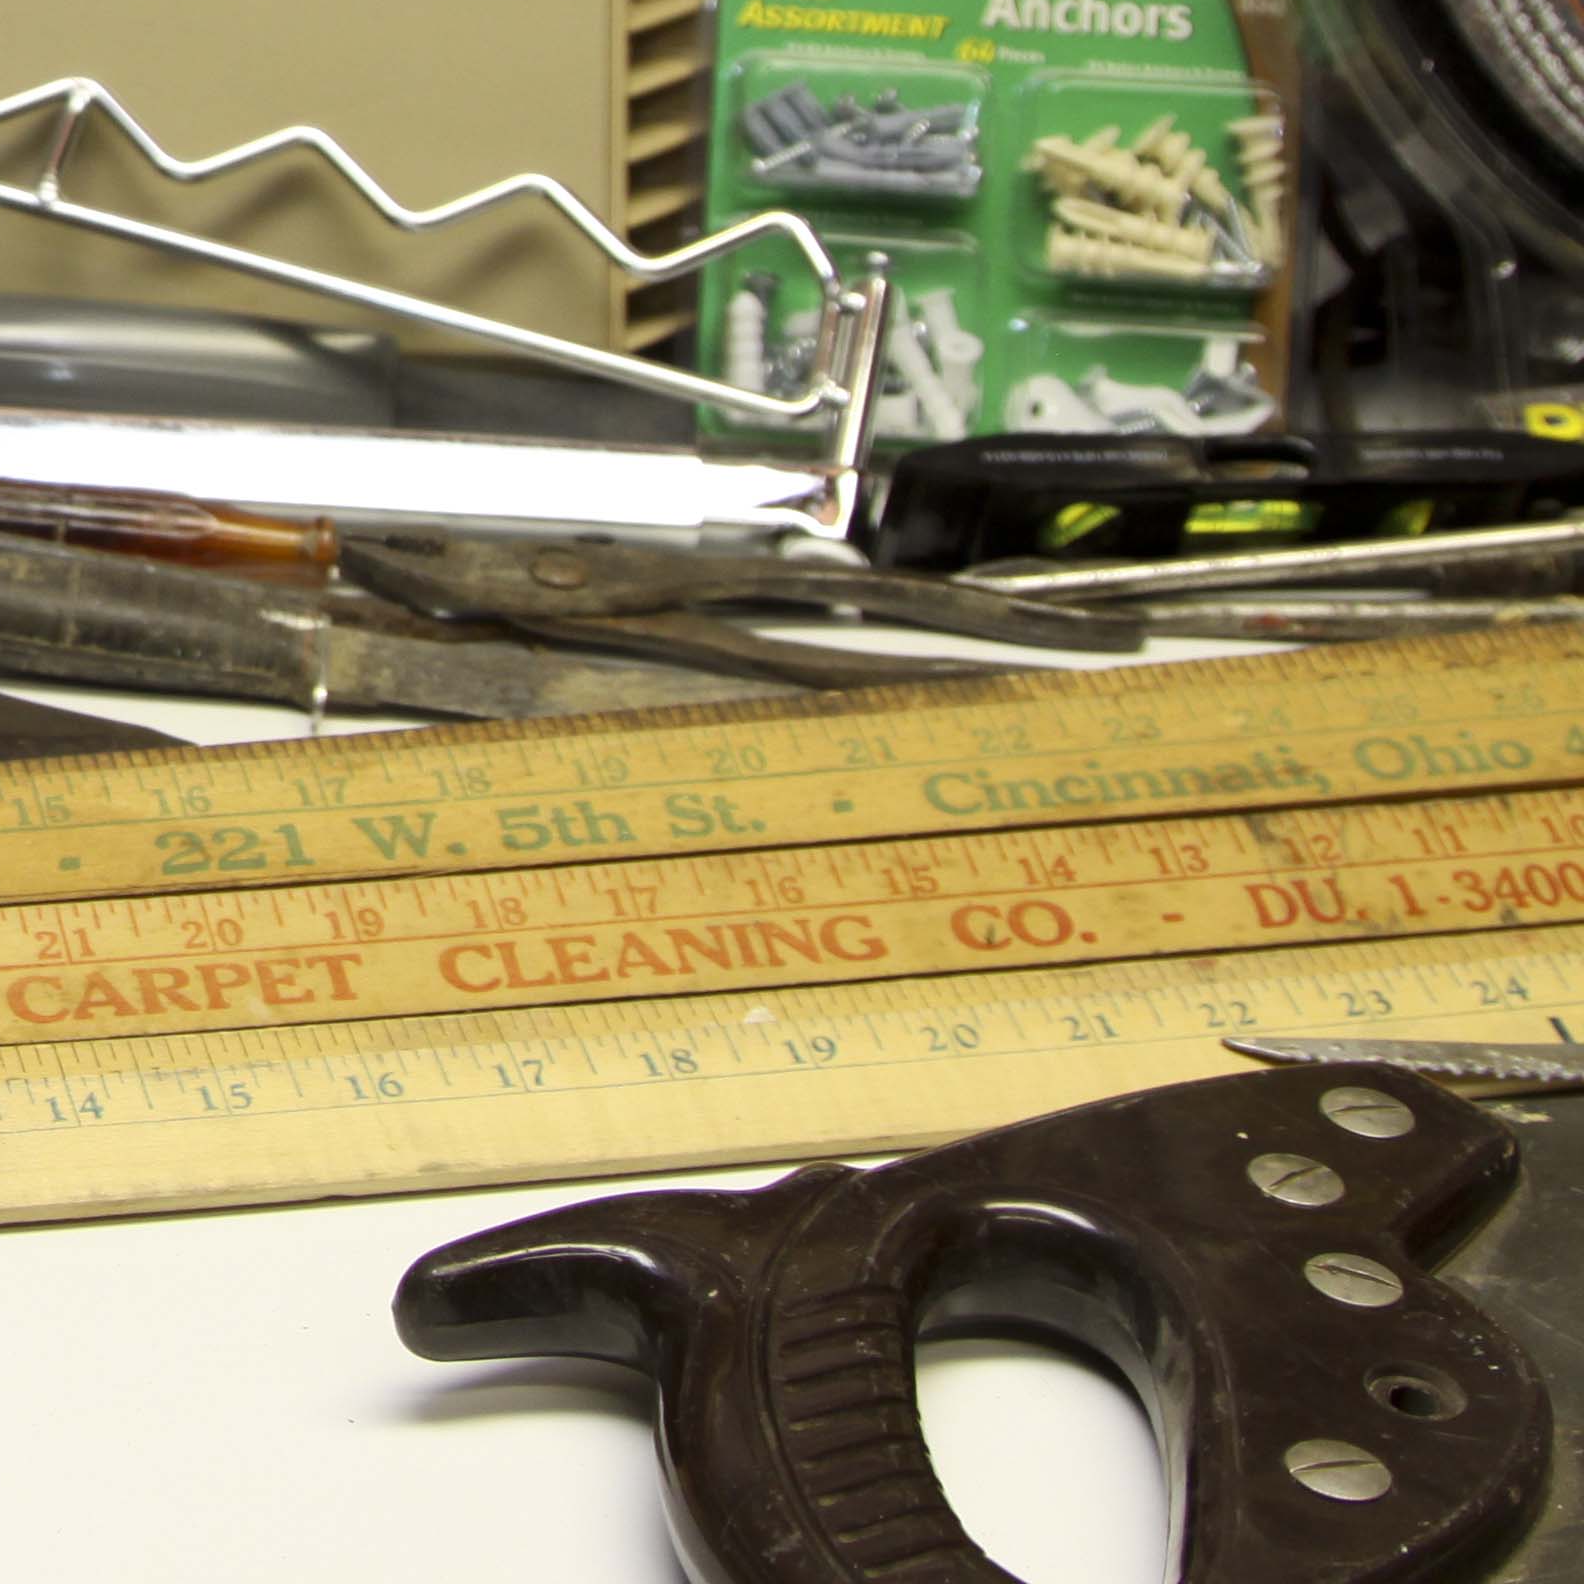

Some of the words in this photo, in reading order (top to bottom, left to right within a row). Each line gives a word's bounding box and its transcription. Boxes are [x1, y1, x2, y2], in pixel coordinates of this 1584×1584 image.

[12, 794, 71, 827] 15
[153, 786, 213, 816] 16
[293, 777, 350, 808] 17
[435, 767, 492, 798] 18
[571, 755, 630, 786] 19
[705, 745, 767, 774] 20
[839, 736, 899, 763] 21
[973, 725, 1031, 753] 22
[1103, 718, 1161, 743] 23
[154, 824, 316, 875] 221
[354, 812, 470, 860] W.
[496, 800, 637, 850] 5th
[664, 792, 766, 839] St.
[923, 744, 1331, 816] Cincinnati,
[1353, 733, 1535, 780] Ohio
[35, 929, 95, 960] 21
[181, 919, 244, 949] 20
[324, 908, 385, 939] 19
[467, 899, 528, 929] 18
[606, 886, 661, 916] 17
[746, 878, 804, 907] 16
[883, 866, 939, 895] 15
[1018, 856, 1078, 885] 14
[1149, 845, 1210, 875] 13
[1283, 835, 1341, 863] 12
[1412, 825, 1468, 855] 11
[5, 954, 363, 1024] CARPET
[438, 914, 889, 994] CLEANING
[950, 899, 1098, 951] CO.
[45, 1093, 105, 1122] 14
[196, 1083, 254, 1112] 15
[347, 1073, 405, 1100] 16
[492, 1059, 546, 1089] 17
[640, 1049, 699, 1078] 18
[784, 1035, 838, 1065] 19
[921, 1024, 982, 1052] 20
[1057, 1014, 1119, 1041] 21
[1199, 1001, 1256, 1027] 22
[1339, 989, 1392, 1016] 23
[1473, 977, 1529, 1006] 24
